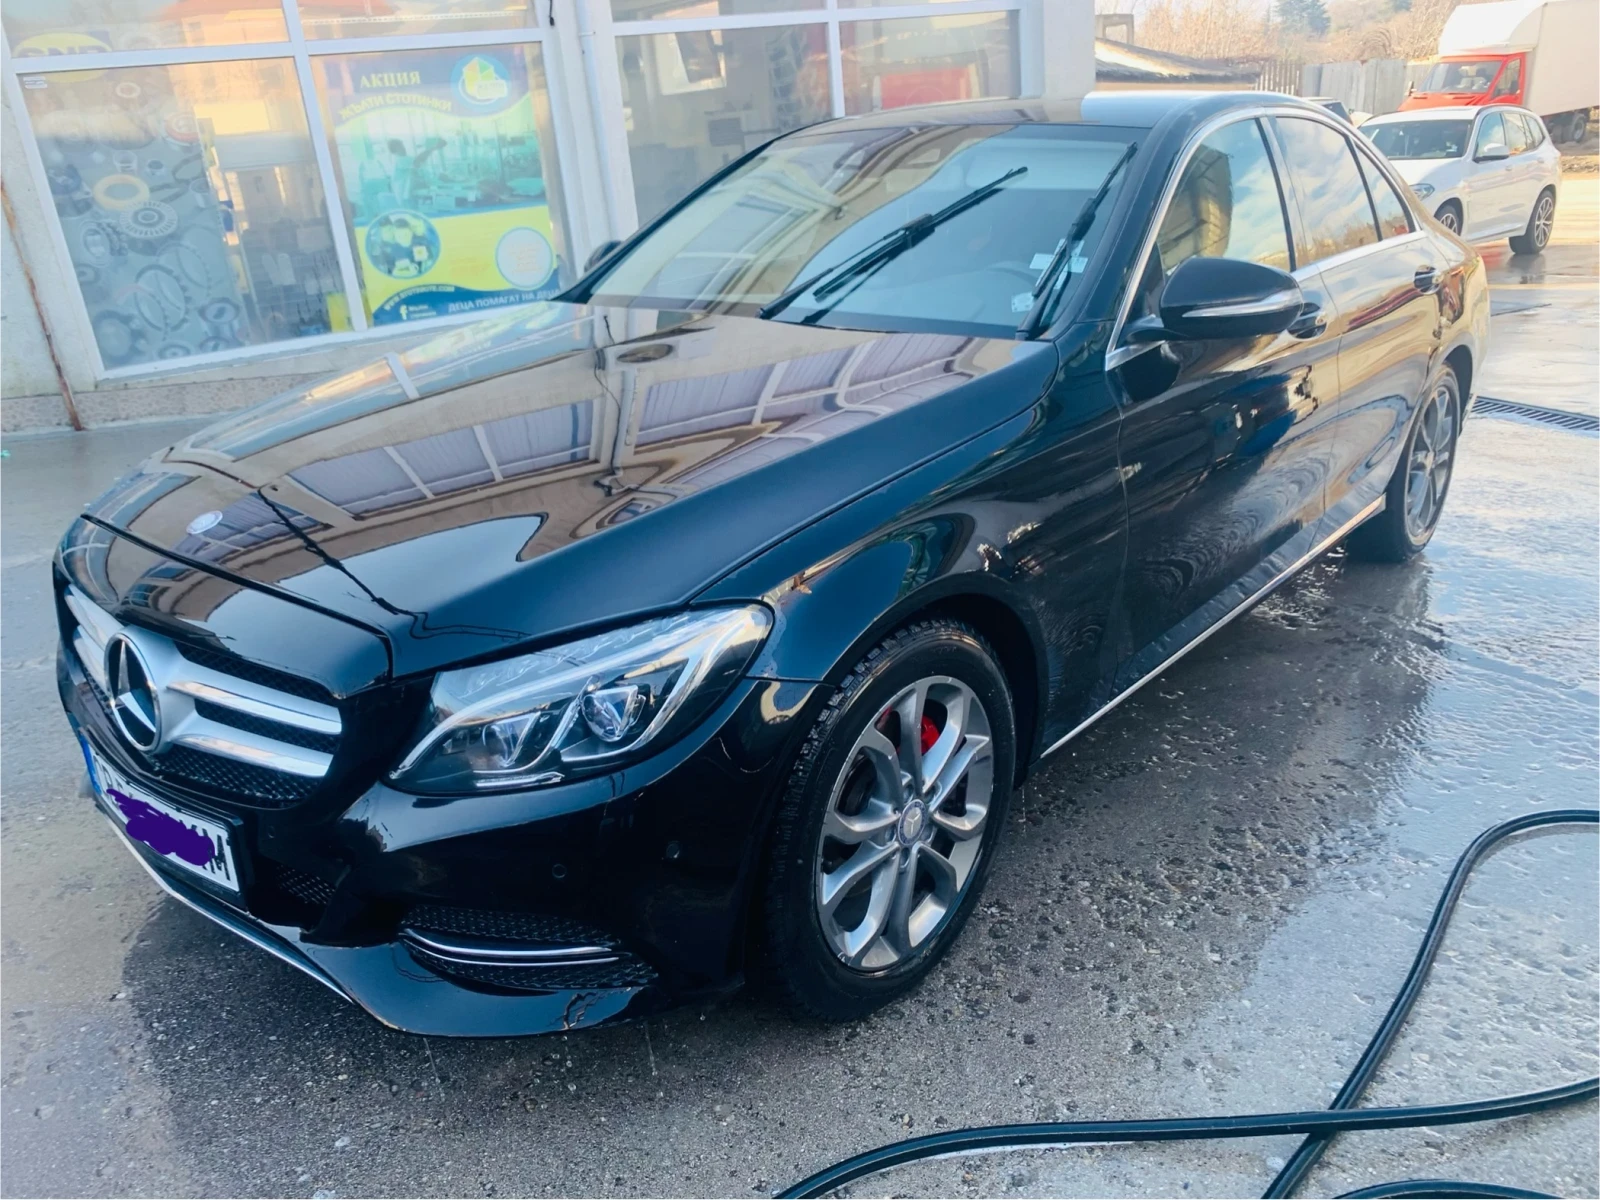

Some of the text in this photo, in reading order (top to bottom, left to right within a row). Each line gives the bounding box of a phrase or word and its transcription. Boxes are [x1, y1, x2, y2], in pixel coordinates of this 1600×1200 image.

[360, 71, 421, 89] АКЦИЯ
[386, 92, 452, 112] СТОТИНКИ
[448, 300, 475, 314] ДЕЦА
[475, 294, 520, 308] ПОМАГАТ
[521, 292, 535, 301] НА
